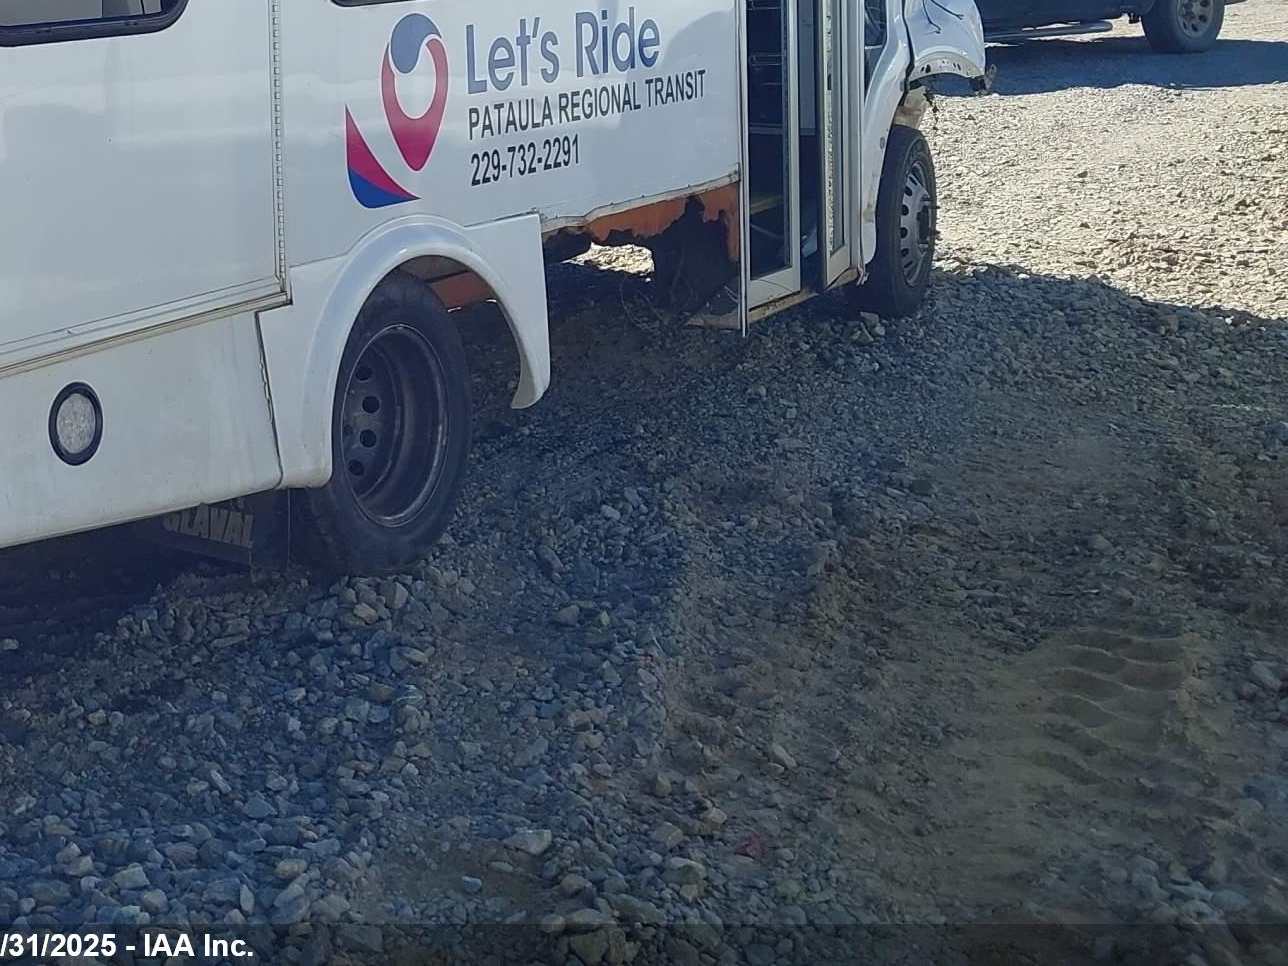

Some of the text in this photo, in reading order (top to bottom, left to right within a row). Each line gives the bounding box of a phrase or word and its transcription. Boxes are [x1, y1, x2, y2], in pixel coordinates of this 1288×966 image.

[465, 6, 661, 95] Let's Ride
[468, 69, 706, 140] PATAULA REGIONAL TRANSIT
[470, 134, 580, 187] 229-732-2291
